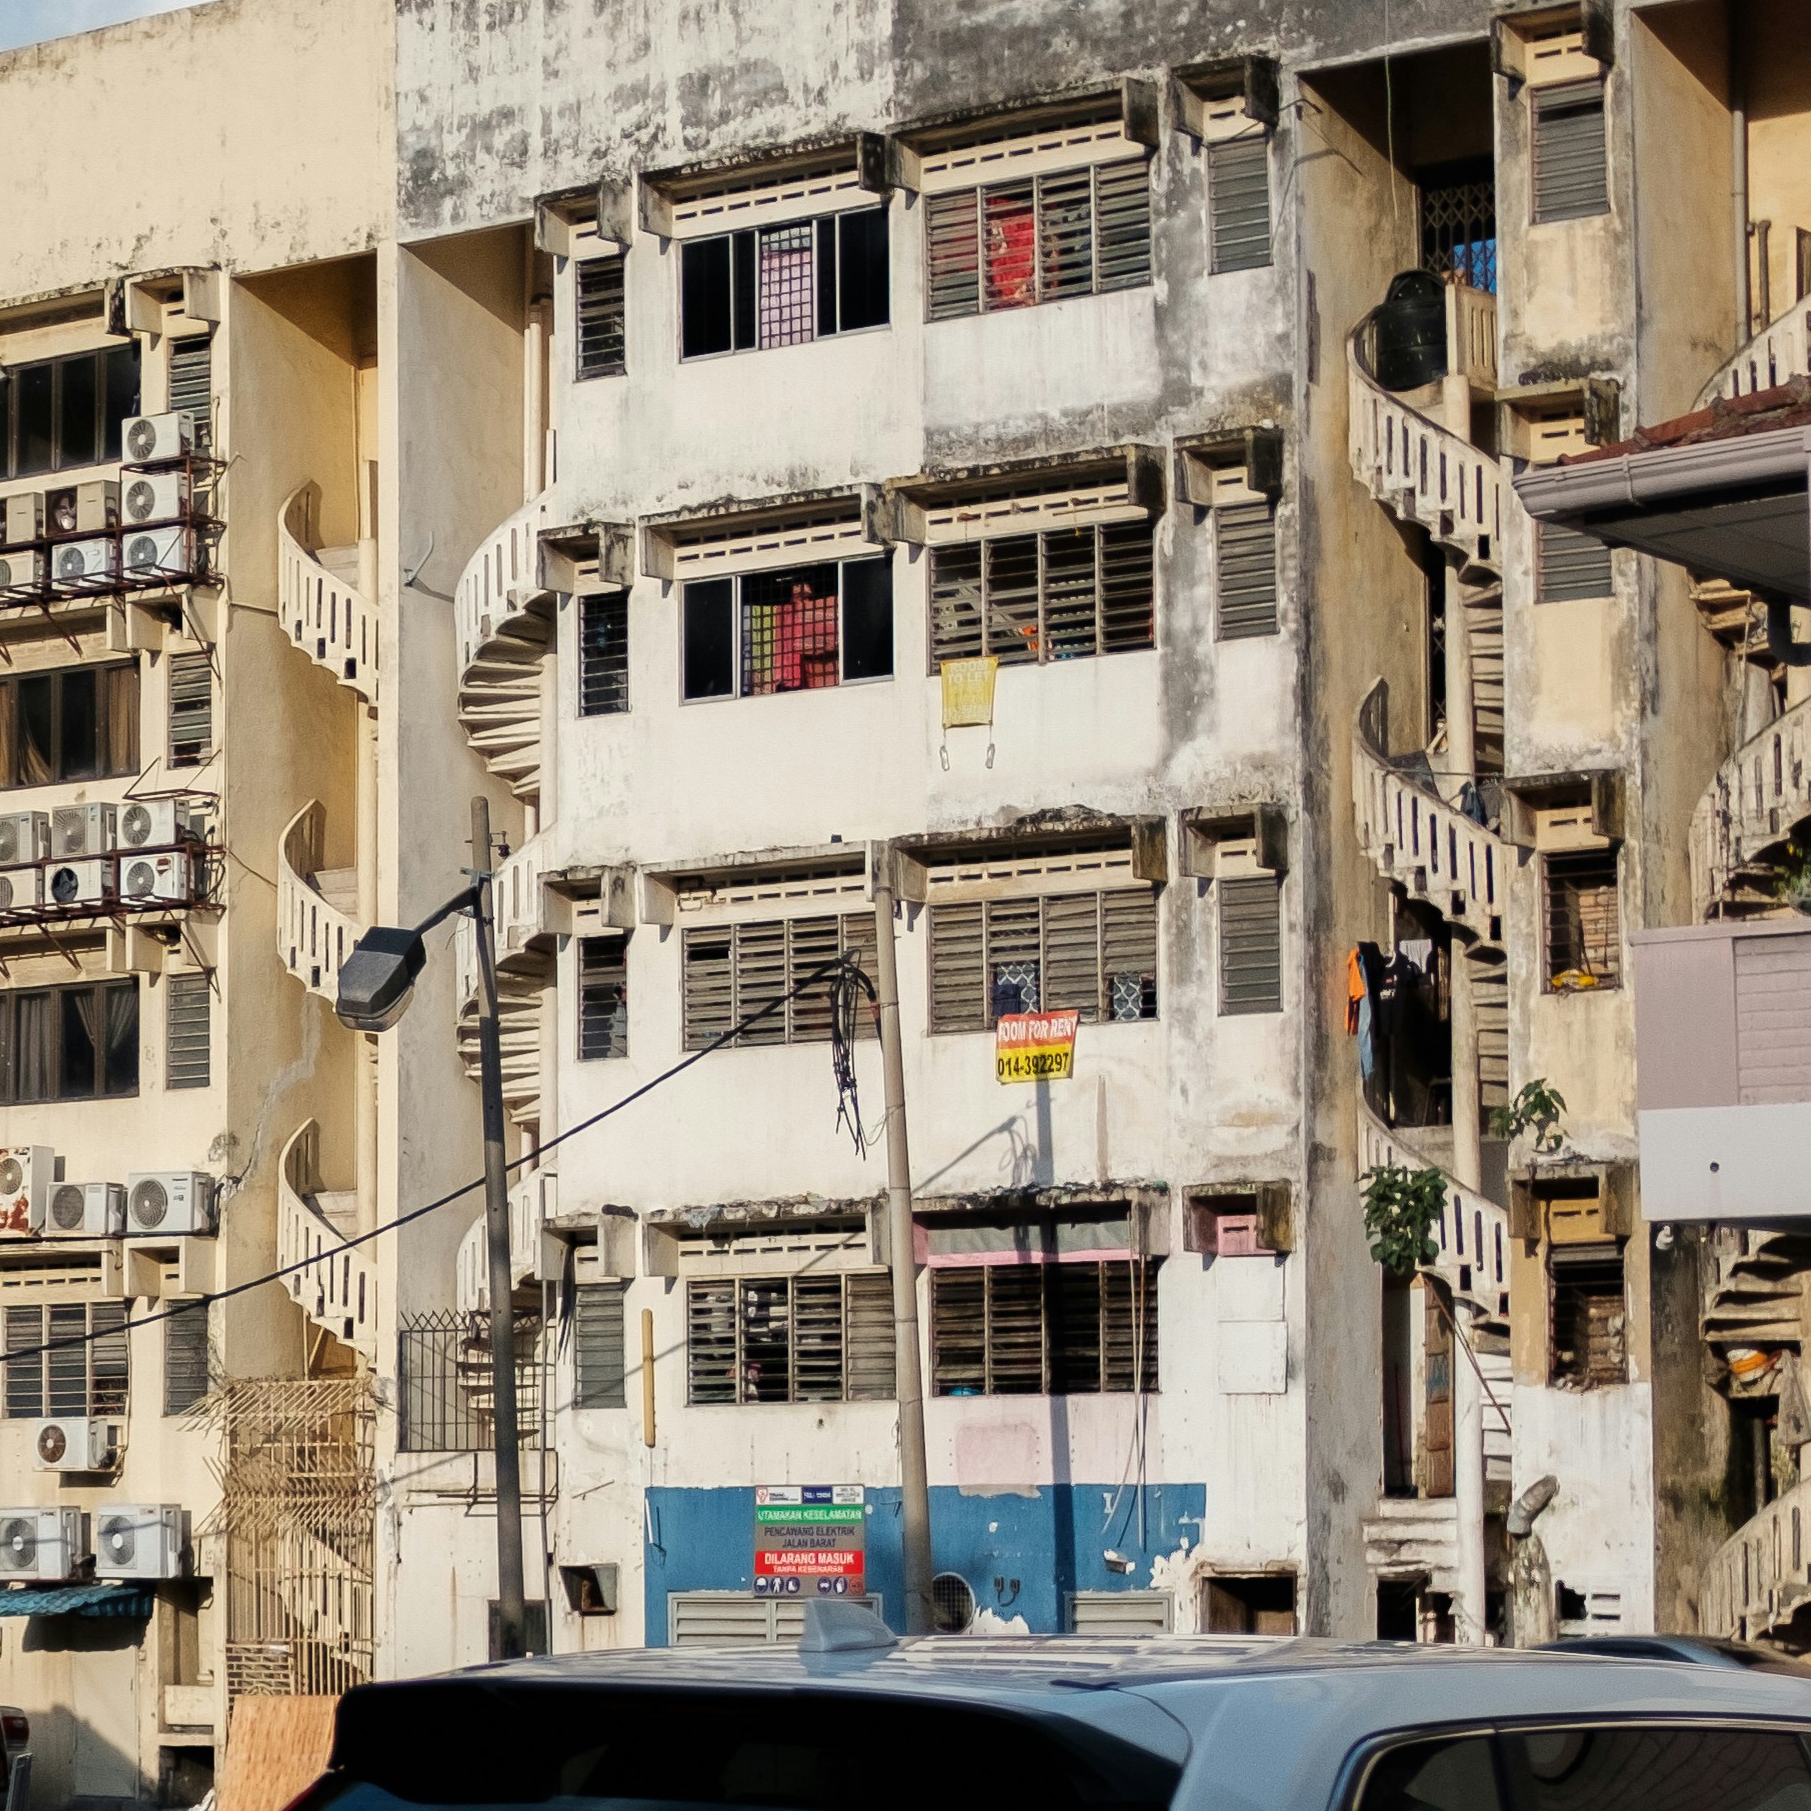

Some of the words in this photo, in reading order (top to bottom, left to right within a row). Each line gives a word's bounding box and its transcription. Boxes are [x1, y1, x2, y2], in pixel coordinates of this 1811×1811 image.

[1028, 1019, 1049, 1040] FOR
[758, 1509, 802, 1521] UTAMAKAN
[803, 1508, 862, 1520] KESELAMATAN
[816, 1526, 855, 1536] ELEKTRIK
[782, 1538, 808, 1548] JALAN
[809, 1538, 836, 1548] BARAT
[764, 1552, 816, 1564] DILARANG
[818, 1553, 854, 1565] MASUK
